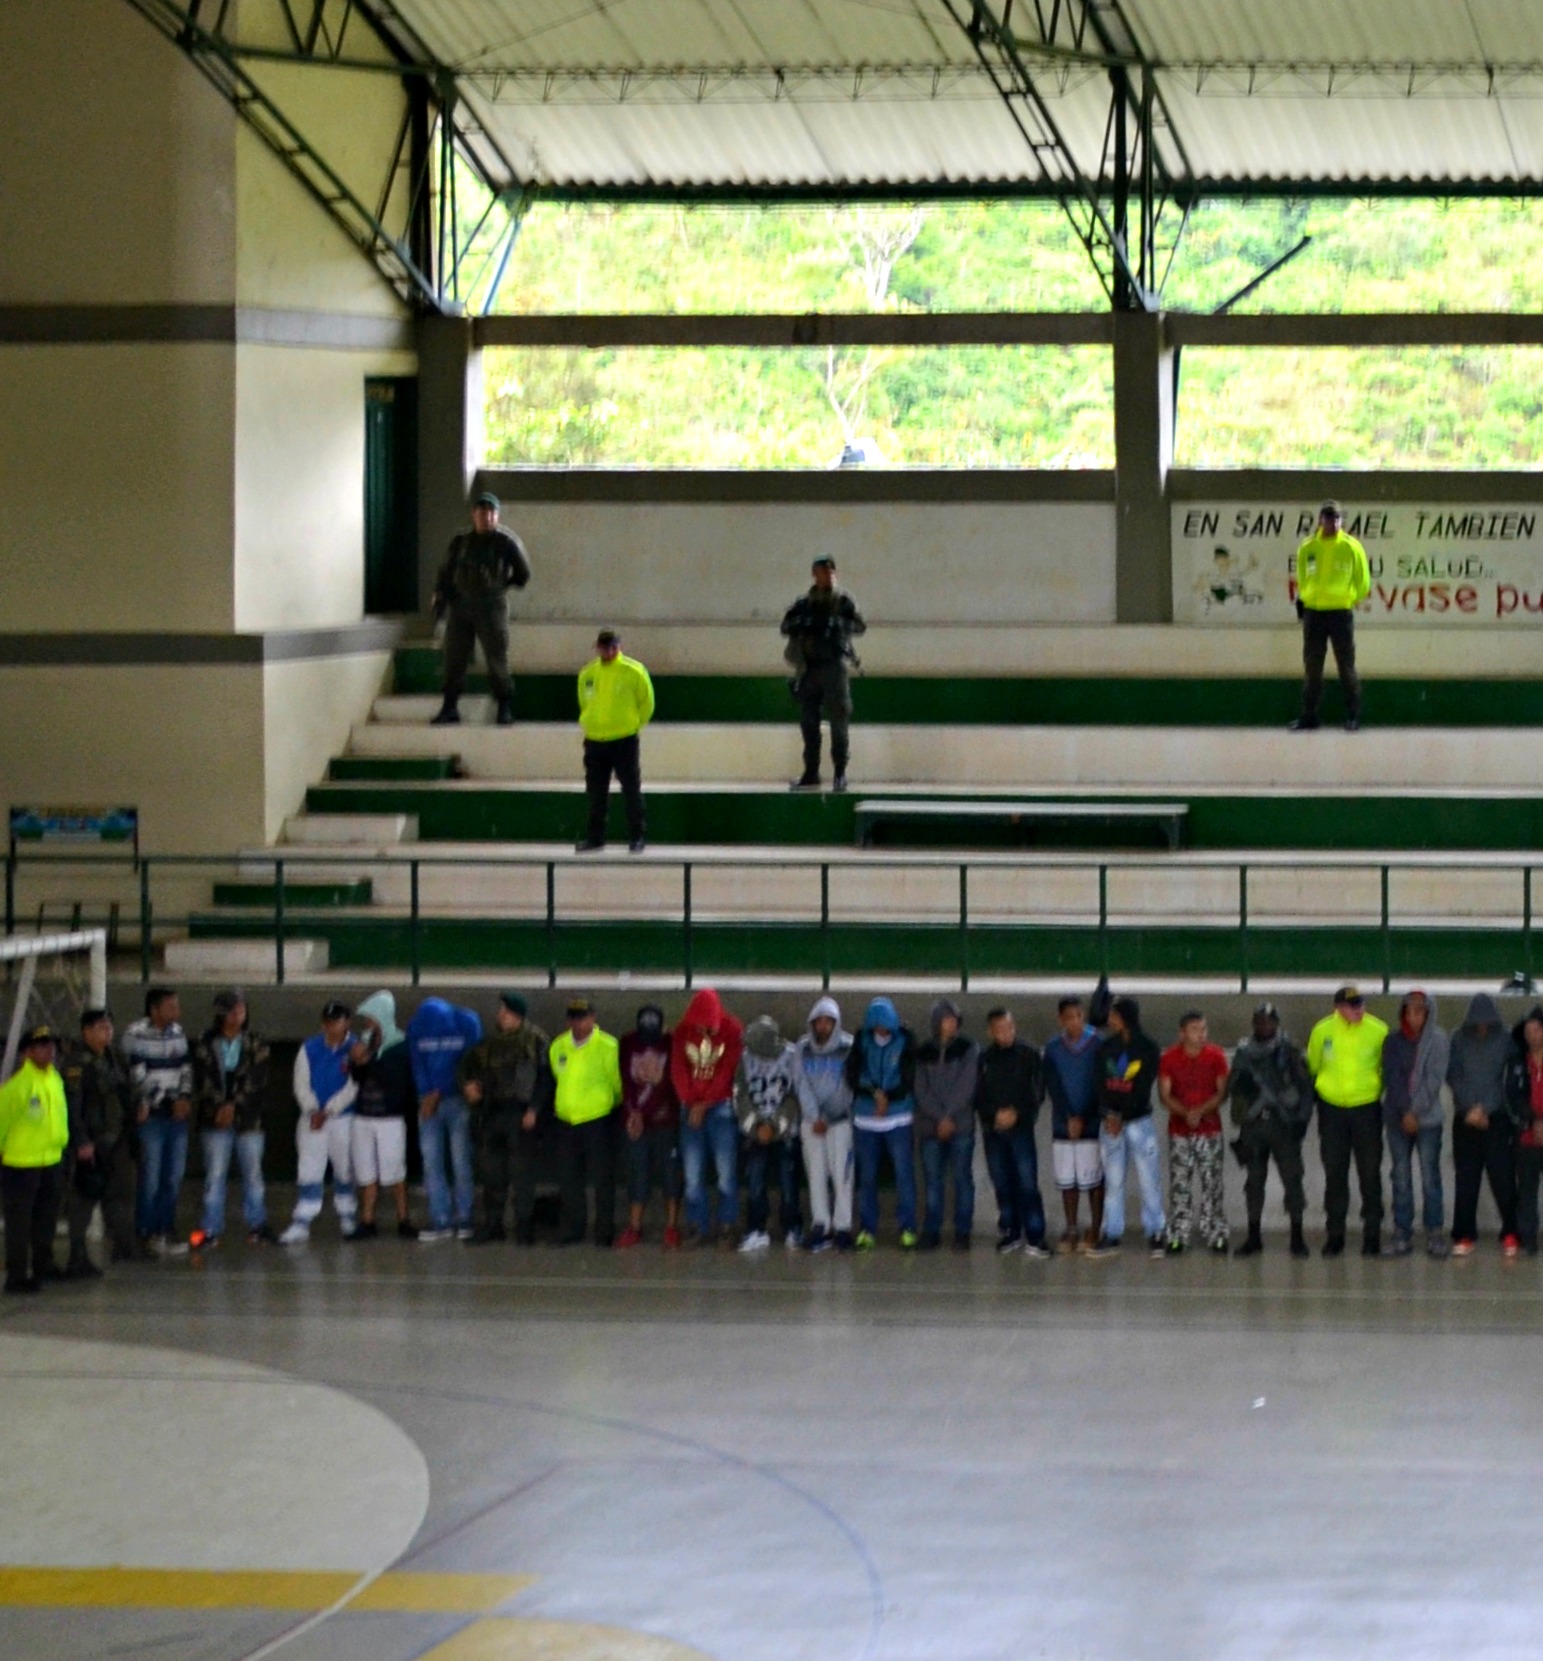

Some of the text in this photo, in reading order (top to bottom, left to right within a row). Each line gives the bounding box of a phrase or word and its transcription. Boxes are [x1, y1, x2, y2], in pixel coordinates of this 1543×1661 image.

[1184, 509, 1219, 538] EN
[1233, 509, 1283, 538] SAN
[1416, 510, 1536, 540] TAMBIEN
